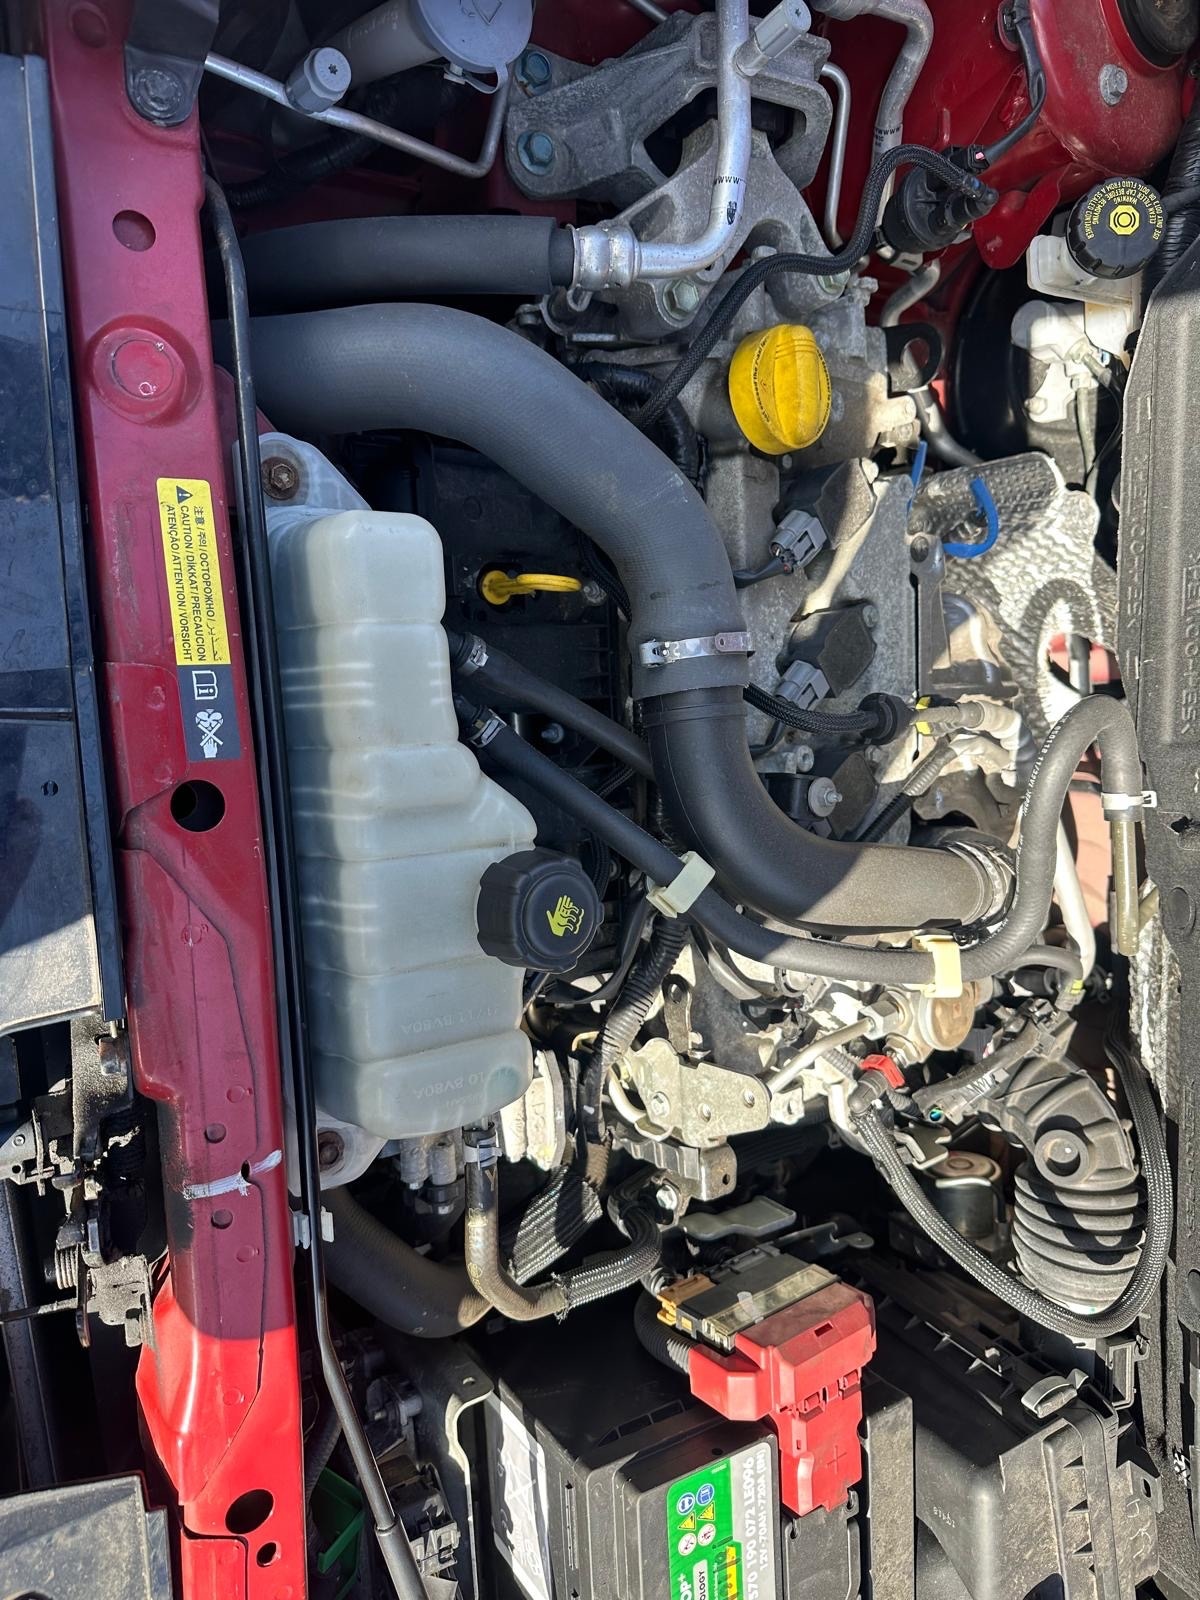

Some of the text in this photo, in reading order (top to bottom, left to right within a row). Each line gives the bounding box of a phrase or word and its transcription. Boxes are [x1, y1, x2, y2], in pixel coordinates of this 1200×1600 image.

[1105, 188, 1124, 200] BEFORE
[1106, 182, 1120, 191] FROM
[1122, 180, 1137, 188] FLUID
[1087, 192, 1102, 210] SEALED
[1113, 196, 1138, 205] WARNING
[1136, 192, 1151, 208] FILLER
[1148, 192, 1156, 200] OR
[1092, 198, 1106, 224] REMOVING
[1148, 207, 1156, 224] CLEAN
[1156, 216, 1164, 228] ONLY
[1084, 210, 1094, 240] CONTAINER
[1152, 228, 1162, 240] USE
[166, 504, 180, 550] ATENÇÃO
[180, 506, 194, 548] CAUTION
[194, 506, 205, 525] 注意
[200, 552, 215, 617] ОСТОРОЖНО
[172, 555, 186, 607] ATTENTION
[186, 555, 198, 592] DİKKAT
[180, 612, 192, 662] VORSICHT
[192, 596, 206, 661] PRECAUCION
[744, 1507, 756, 1538] 072
